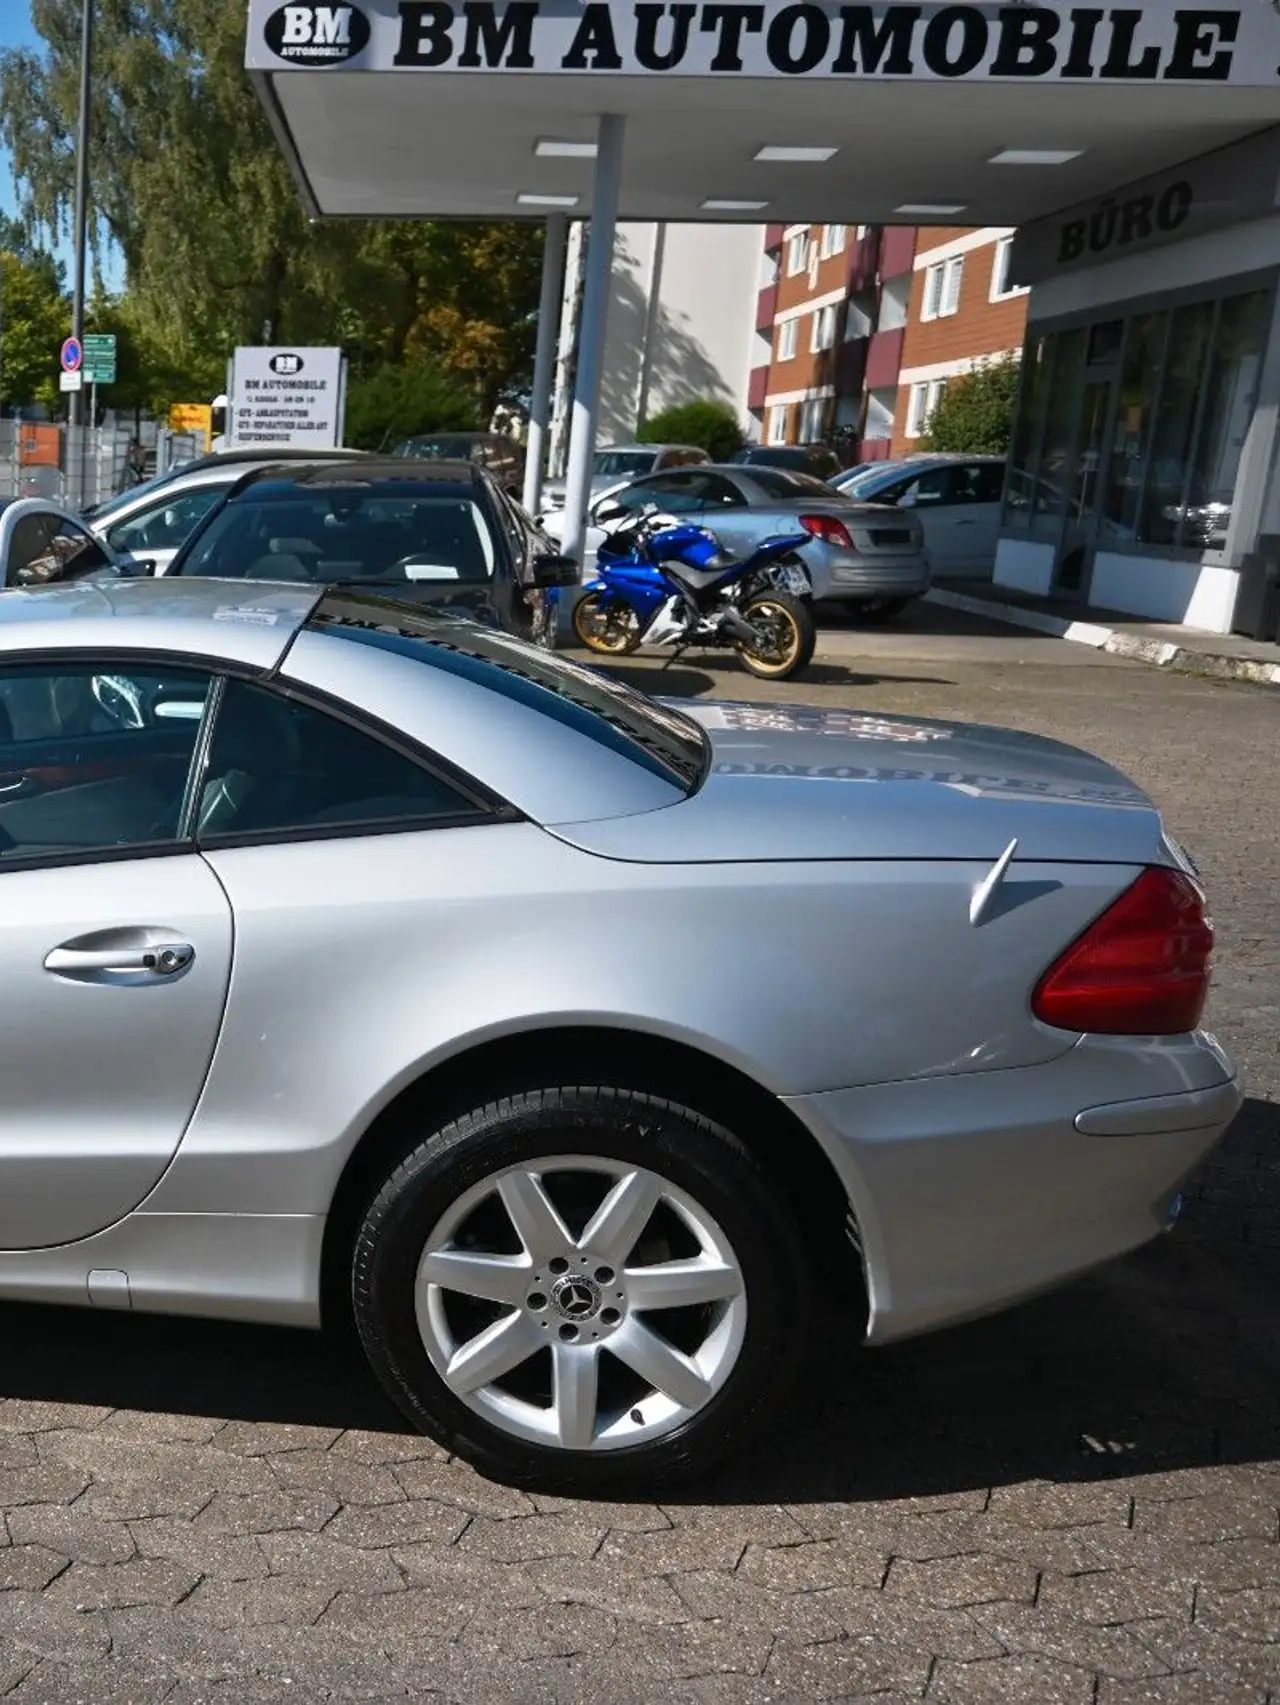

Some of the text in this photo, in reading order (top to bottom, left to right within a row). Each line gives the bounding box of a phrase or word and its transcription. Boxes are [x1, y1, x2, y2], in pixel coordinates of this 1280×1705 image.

[282, 7, 352, 43] BM
[392, 2, 1241, 80] BM AUTOMOBILE
[280, 46, 349, 56] AUTOMOBILE
[1056, 180, 1193, 263] BÜRO
[262, 380, 327, 390] AUTOMOBILE
